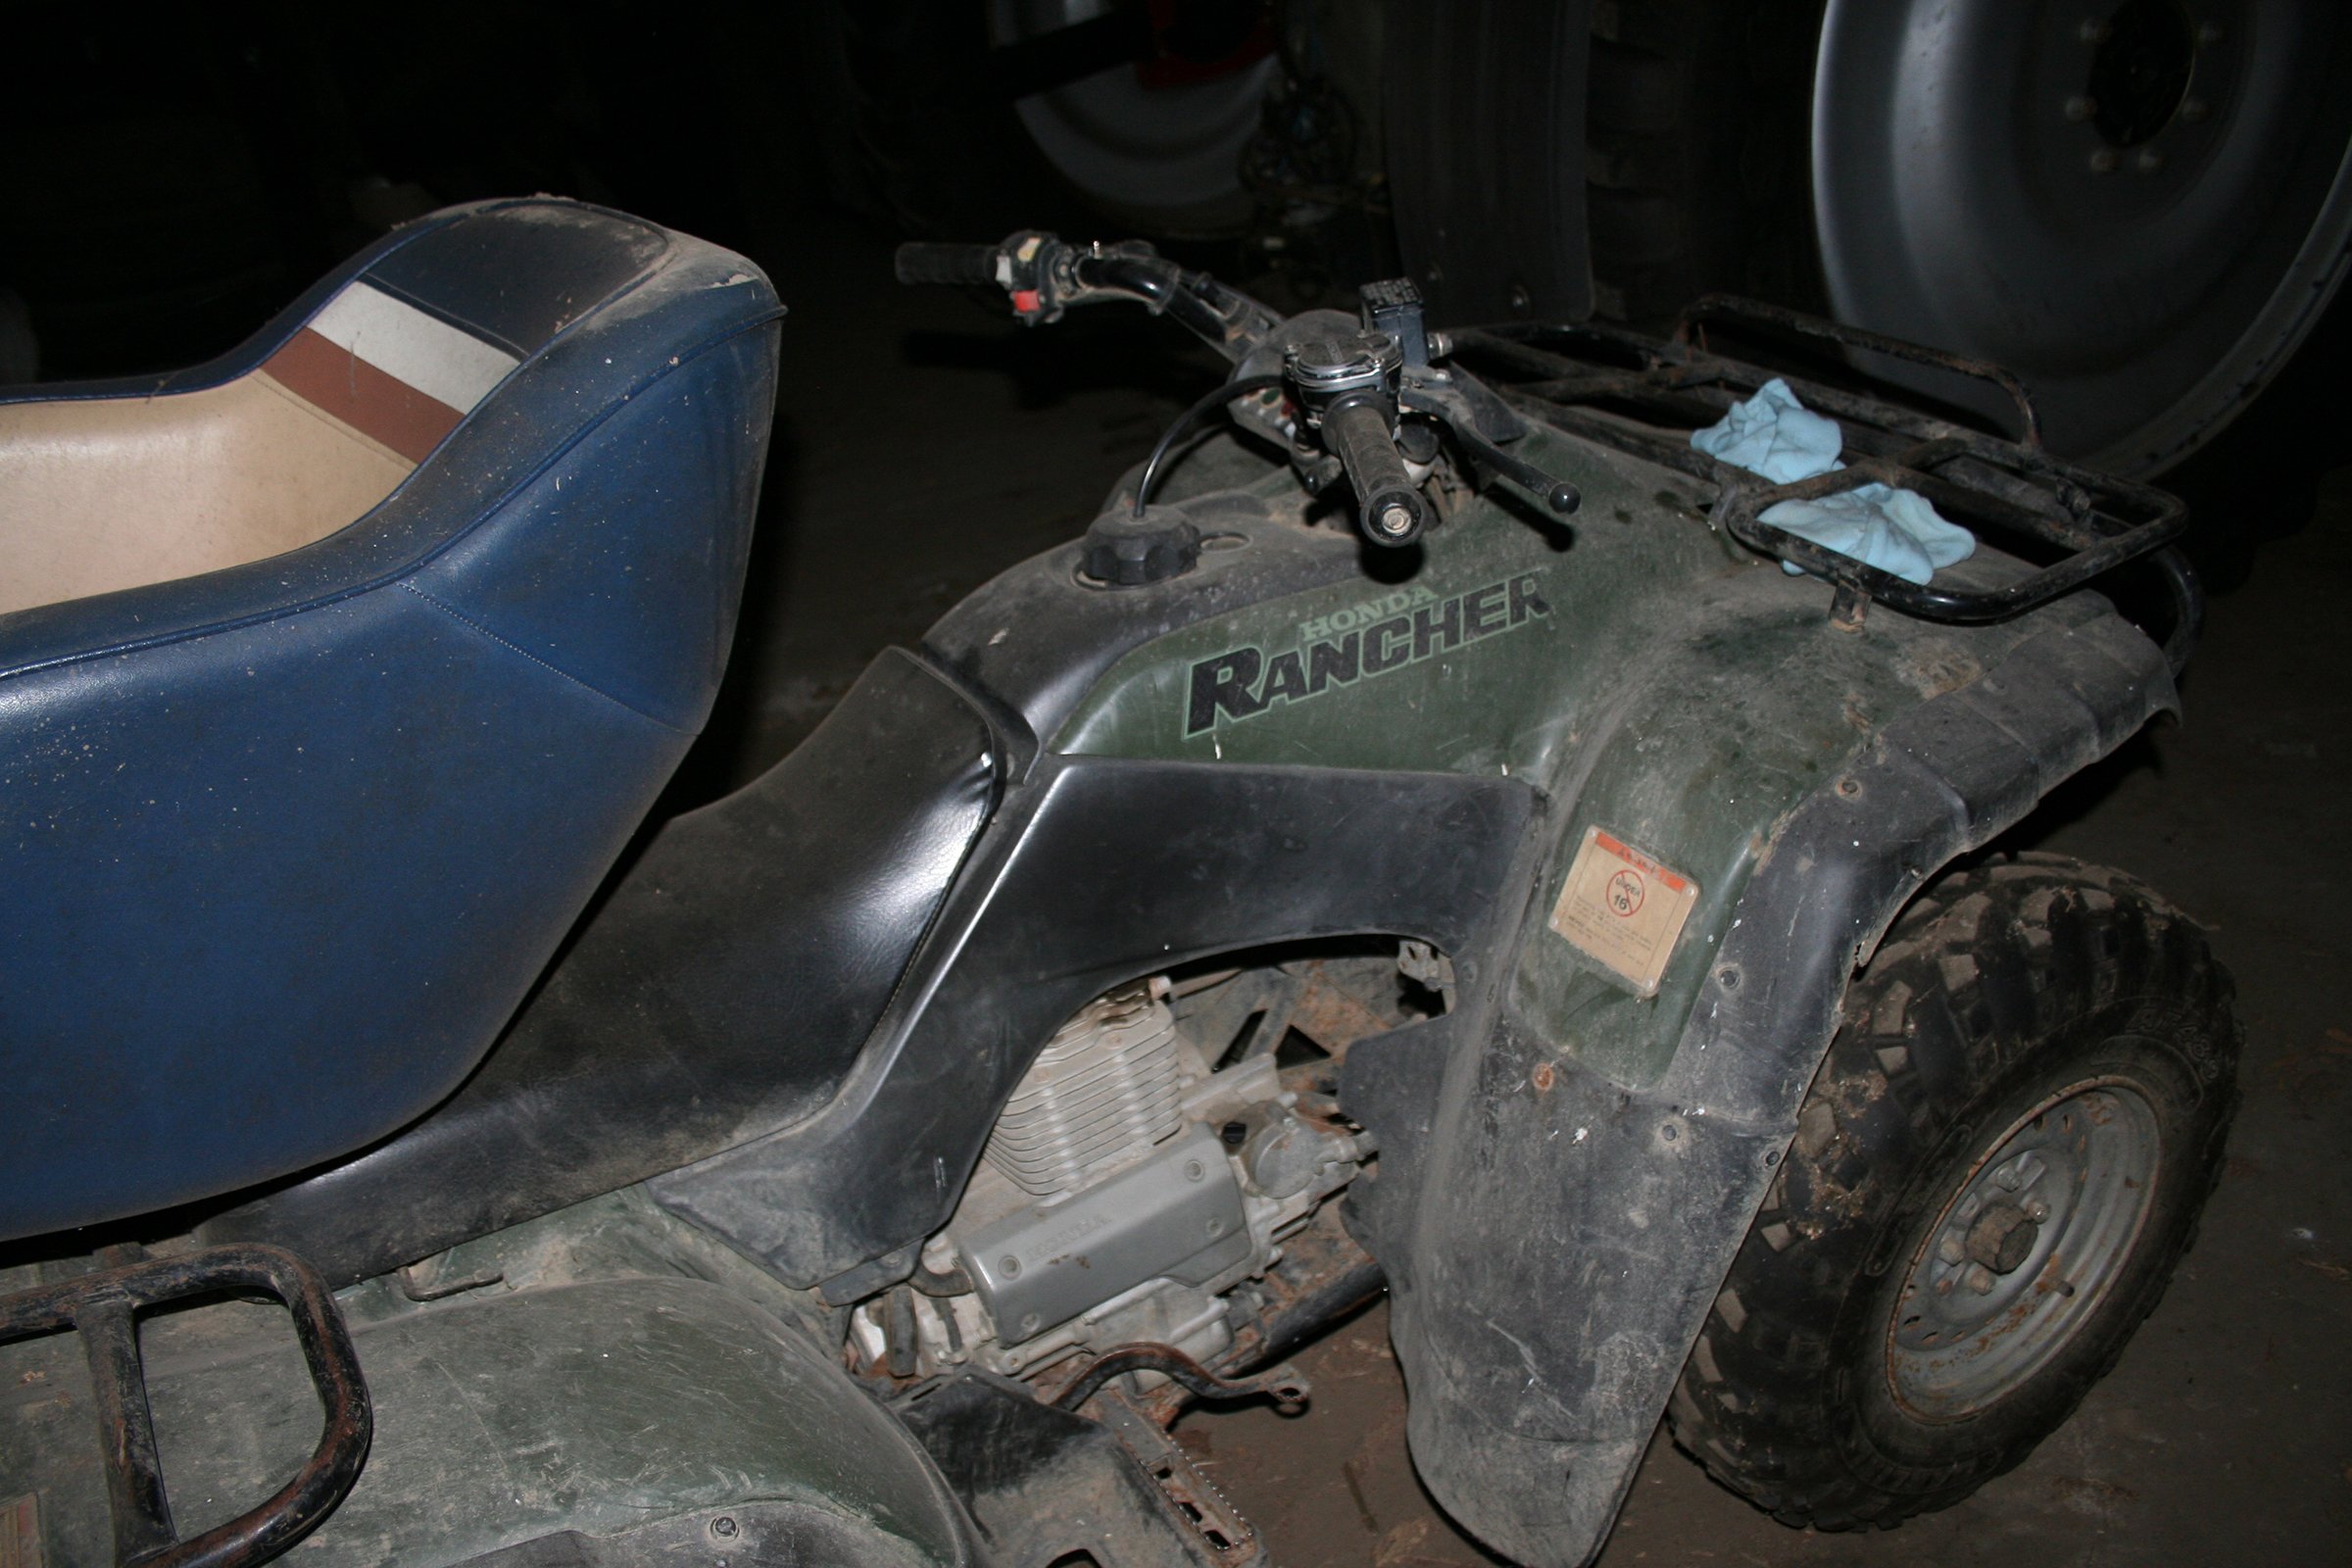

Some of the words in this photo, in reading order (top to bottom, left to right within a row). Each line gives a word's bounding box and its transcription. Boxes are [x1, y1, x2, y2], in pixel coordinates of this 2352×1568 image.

[1298, 586, 1440, 643] HONDA
[1182, 572, 1551, 740] RANCHER
[1613, 894, 1628, 911] 16
